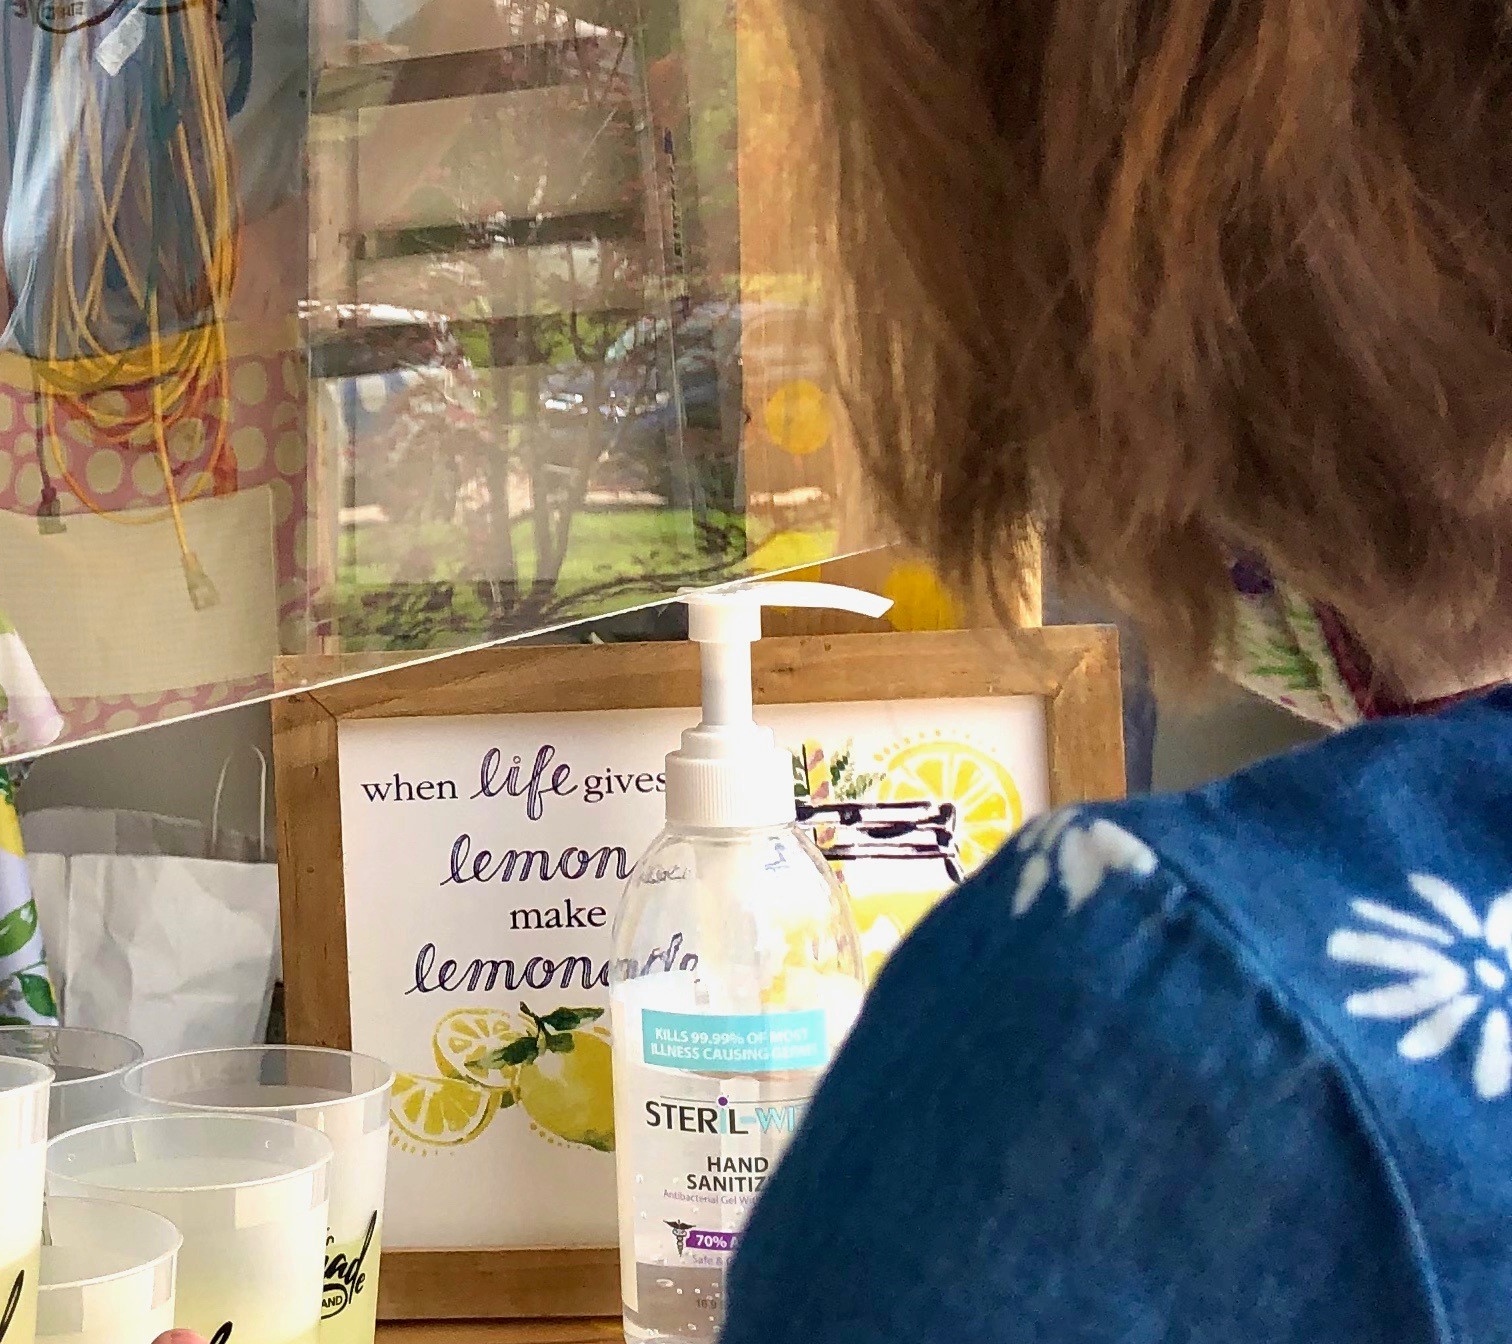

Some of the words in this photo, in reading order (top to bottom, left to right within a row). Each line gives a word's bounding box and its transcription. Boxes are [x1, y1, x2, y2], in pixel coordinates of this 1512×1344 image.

[360, 772, 459, 803] when
[470, 744, 578, 821] life
[583, 767, 668, 803] gives
[509, 898, 608, 930] make
[655, 1028, 689, 1042] KILLS
[690, 1031, 744, 1045] 99.99%
[746, 1032, 766, 1045] OF
[651, 1043, 699, 1059] ILLNESS
[703, 1047, 769, 1061] CAUSING
[707, 1156, 769, 1173] HAND
[686, 1174, 767, 1193] SANITIZ
[663, 1189, 719, 1204] Antibacterial
[721, 1195, 737, 1205] Gel
[695, 1234, 728, 1248] 70%
[321, 1295, 343, 1308] AND
